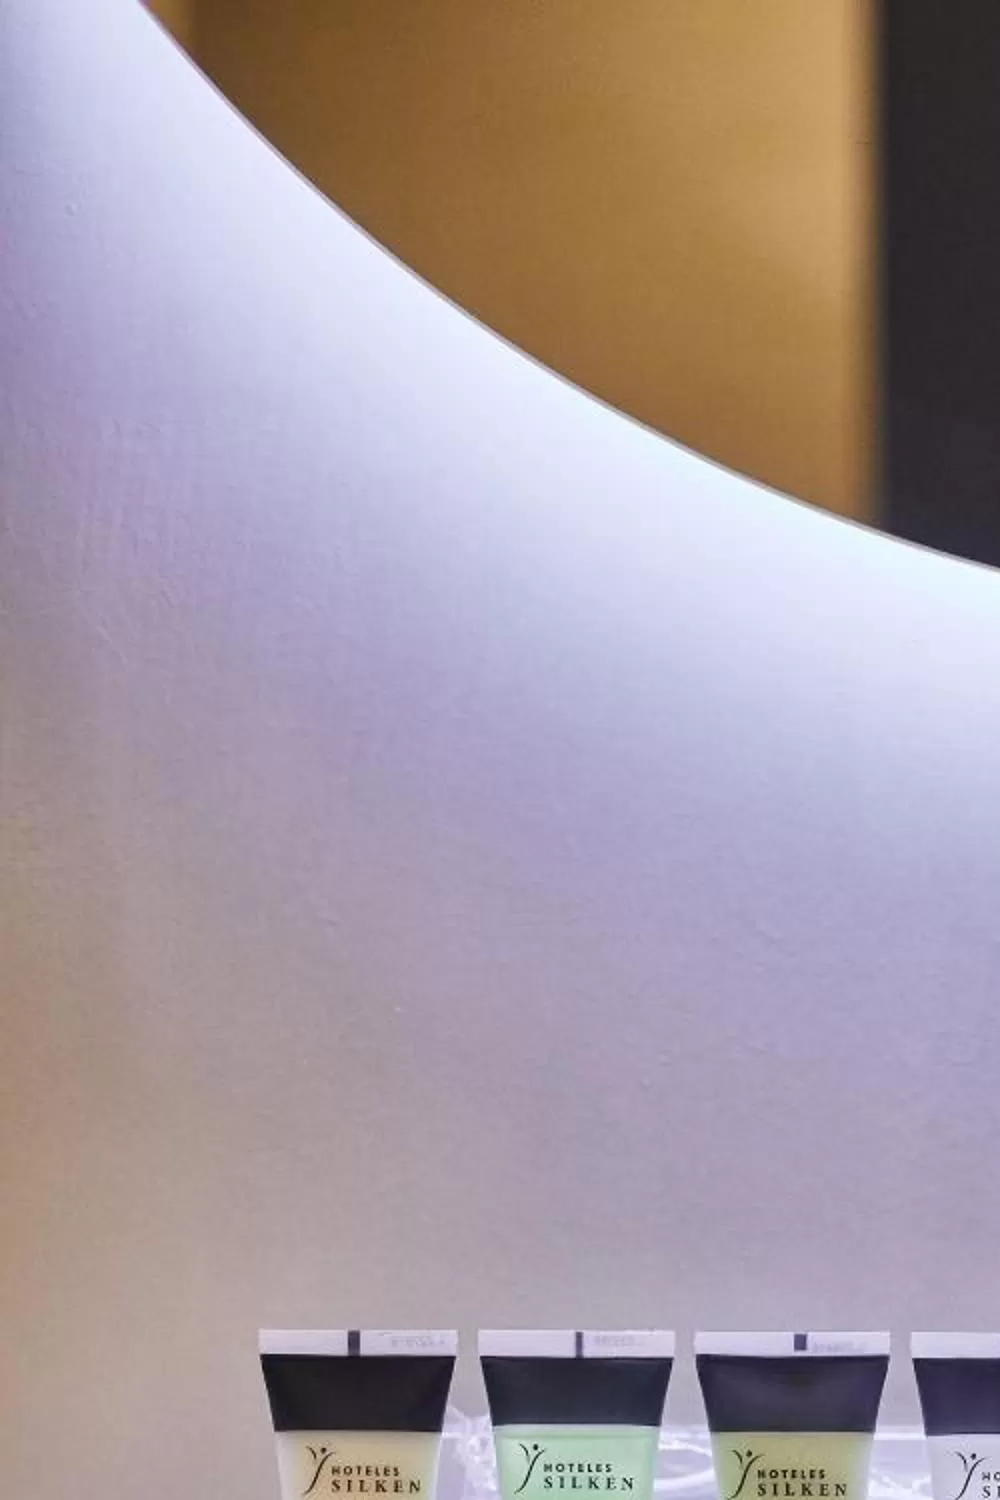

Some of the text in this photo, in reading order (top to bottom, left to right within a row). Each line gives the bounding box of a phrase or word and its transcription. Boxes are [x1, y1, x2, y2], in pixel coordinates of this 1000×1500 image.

[331, 1465, 400, 1477] HOTELES
[543, 1463, 613, 1473] HOTELES
[757, 1469, 826, 1479] HOTELES
[331, 1479, 421, 1494] SILKEN
[543, 1476, 634, 1491] SILKEN
[757, 1483, 848, 1497] SILKEN
